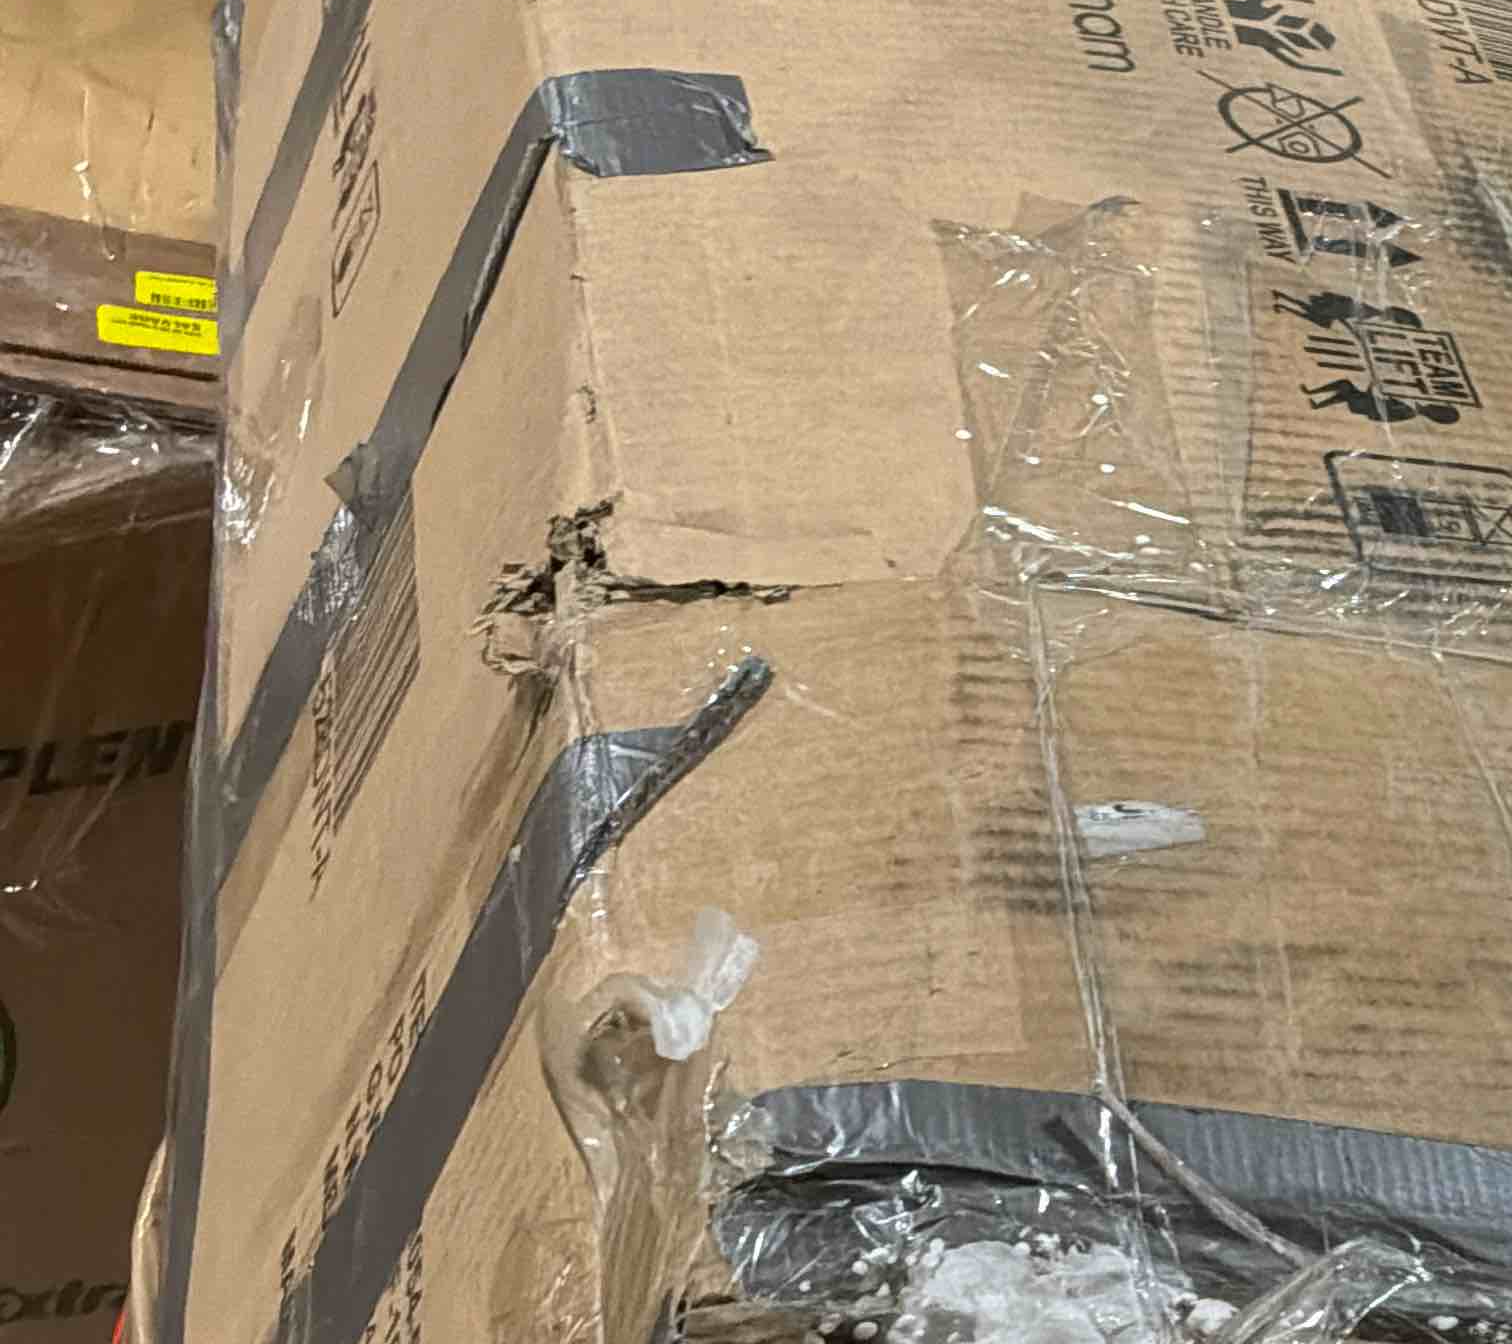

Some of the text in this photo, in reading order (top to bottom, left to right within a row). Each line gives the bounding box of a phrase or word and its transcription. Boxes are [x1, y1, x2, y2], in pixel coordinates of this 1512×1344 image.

[1164, 7, 1204, 58] CARE
[1239, 175, 1297, 265] THIS WAY
[1367, 331, 1430, 397] LIFT
[1411, 336, 1469, 400] TEAM
